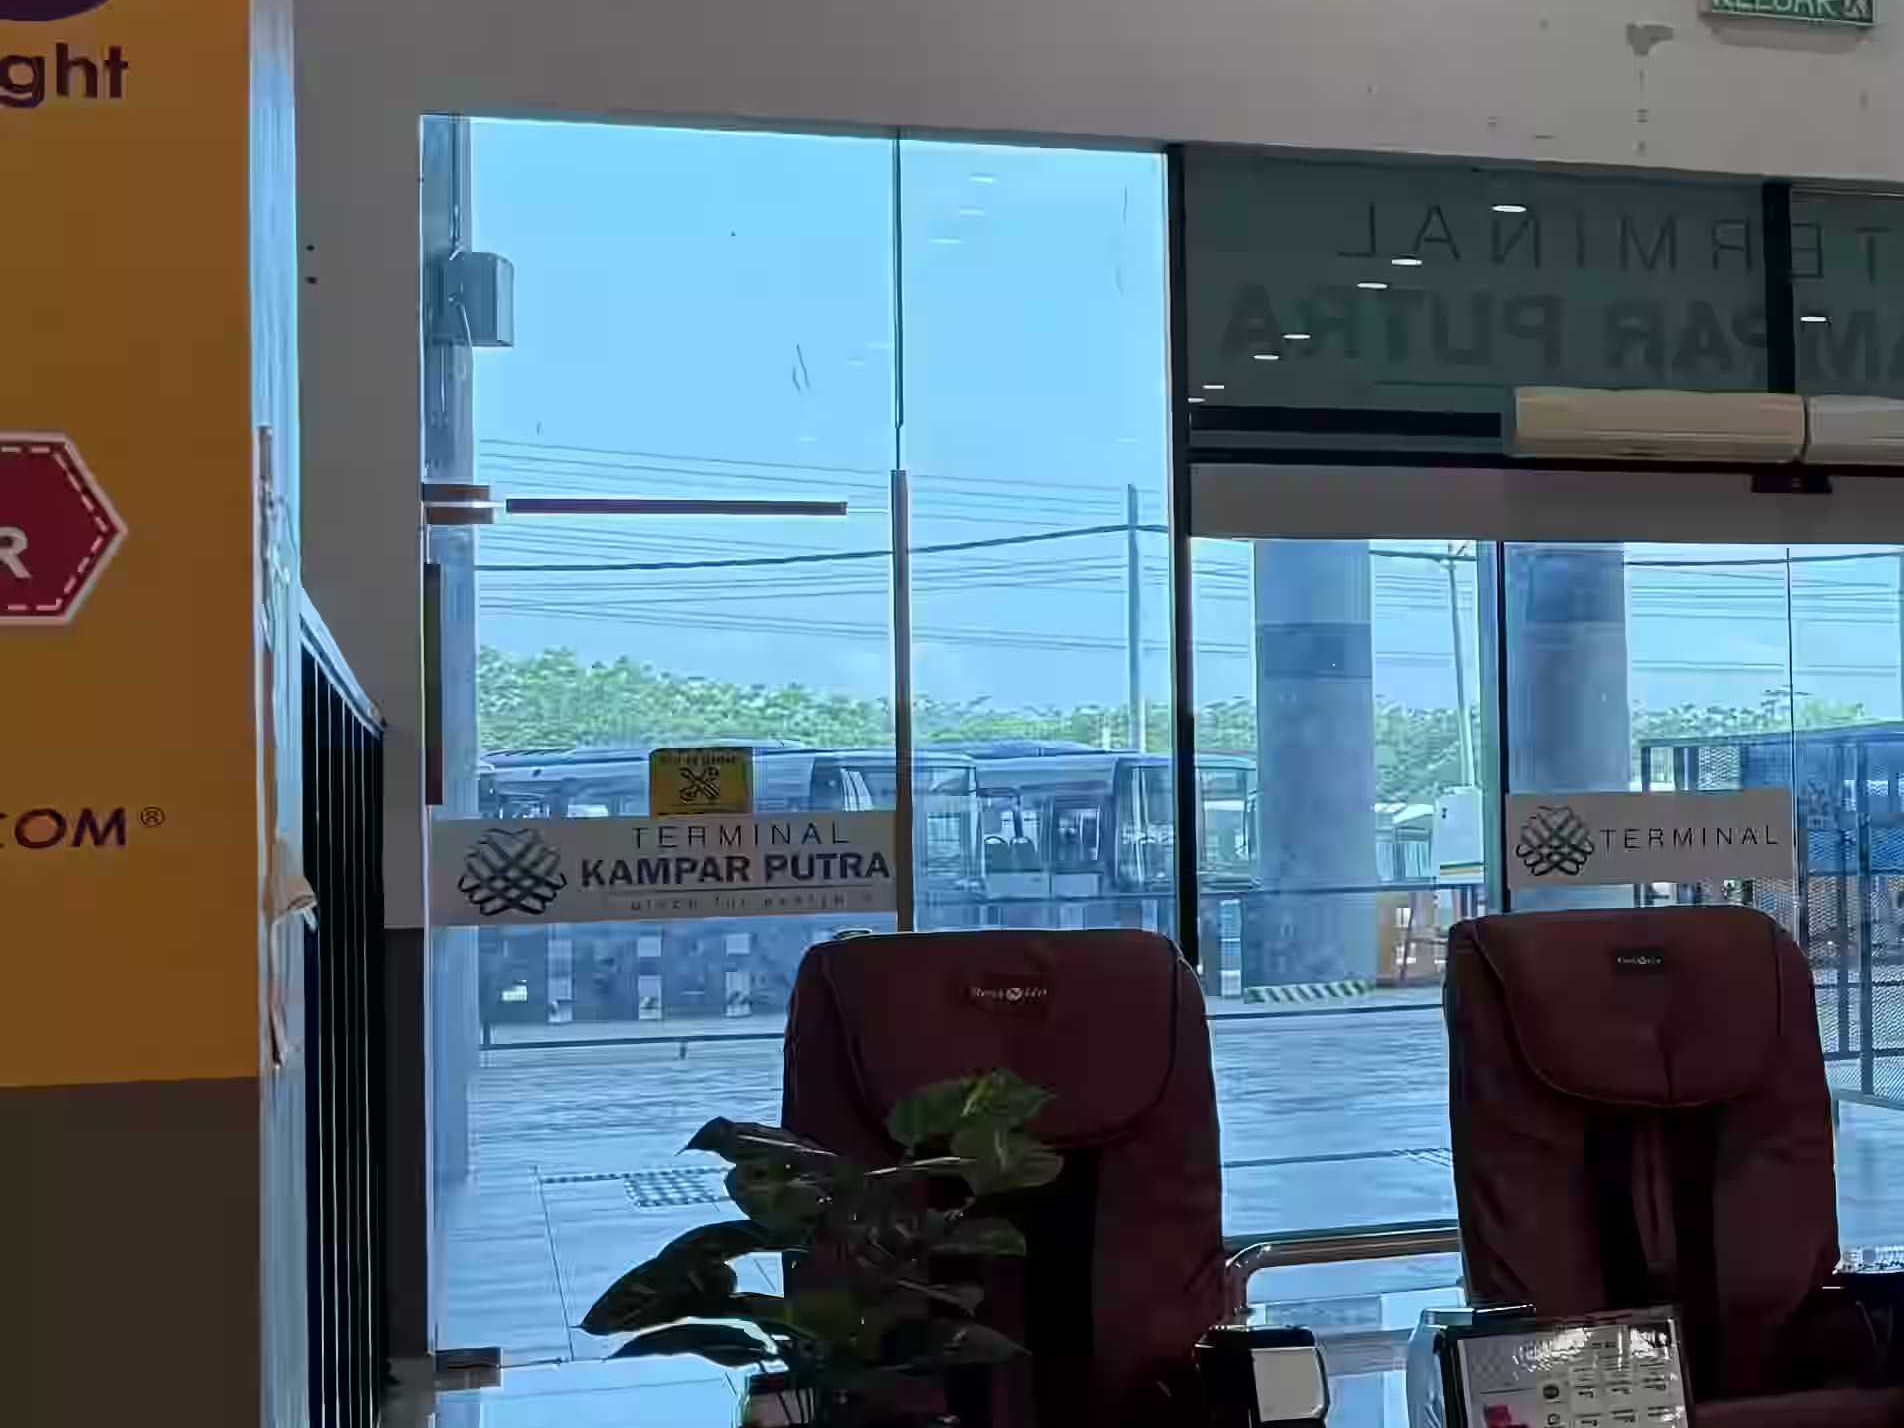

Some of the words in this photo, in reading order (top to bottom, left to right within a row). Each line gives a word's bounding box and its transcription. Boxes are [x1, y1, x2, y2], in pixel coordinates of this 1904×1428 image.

[0, 42, 129, 109] ght
[632, 821, 851, 850] TERMINAL
[1600, 824, 1779, 851] TERMINAL
[581, 855, 751, 887] KAMPAR
[765, 851, 890, 882] PUTRA
